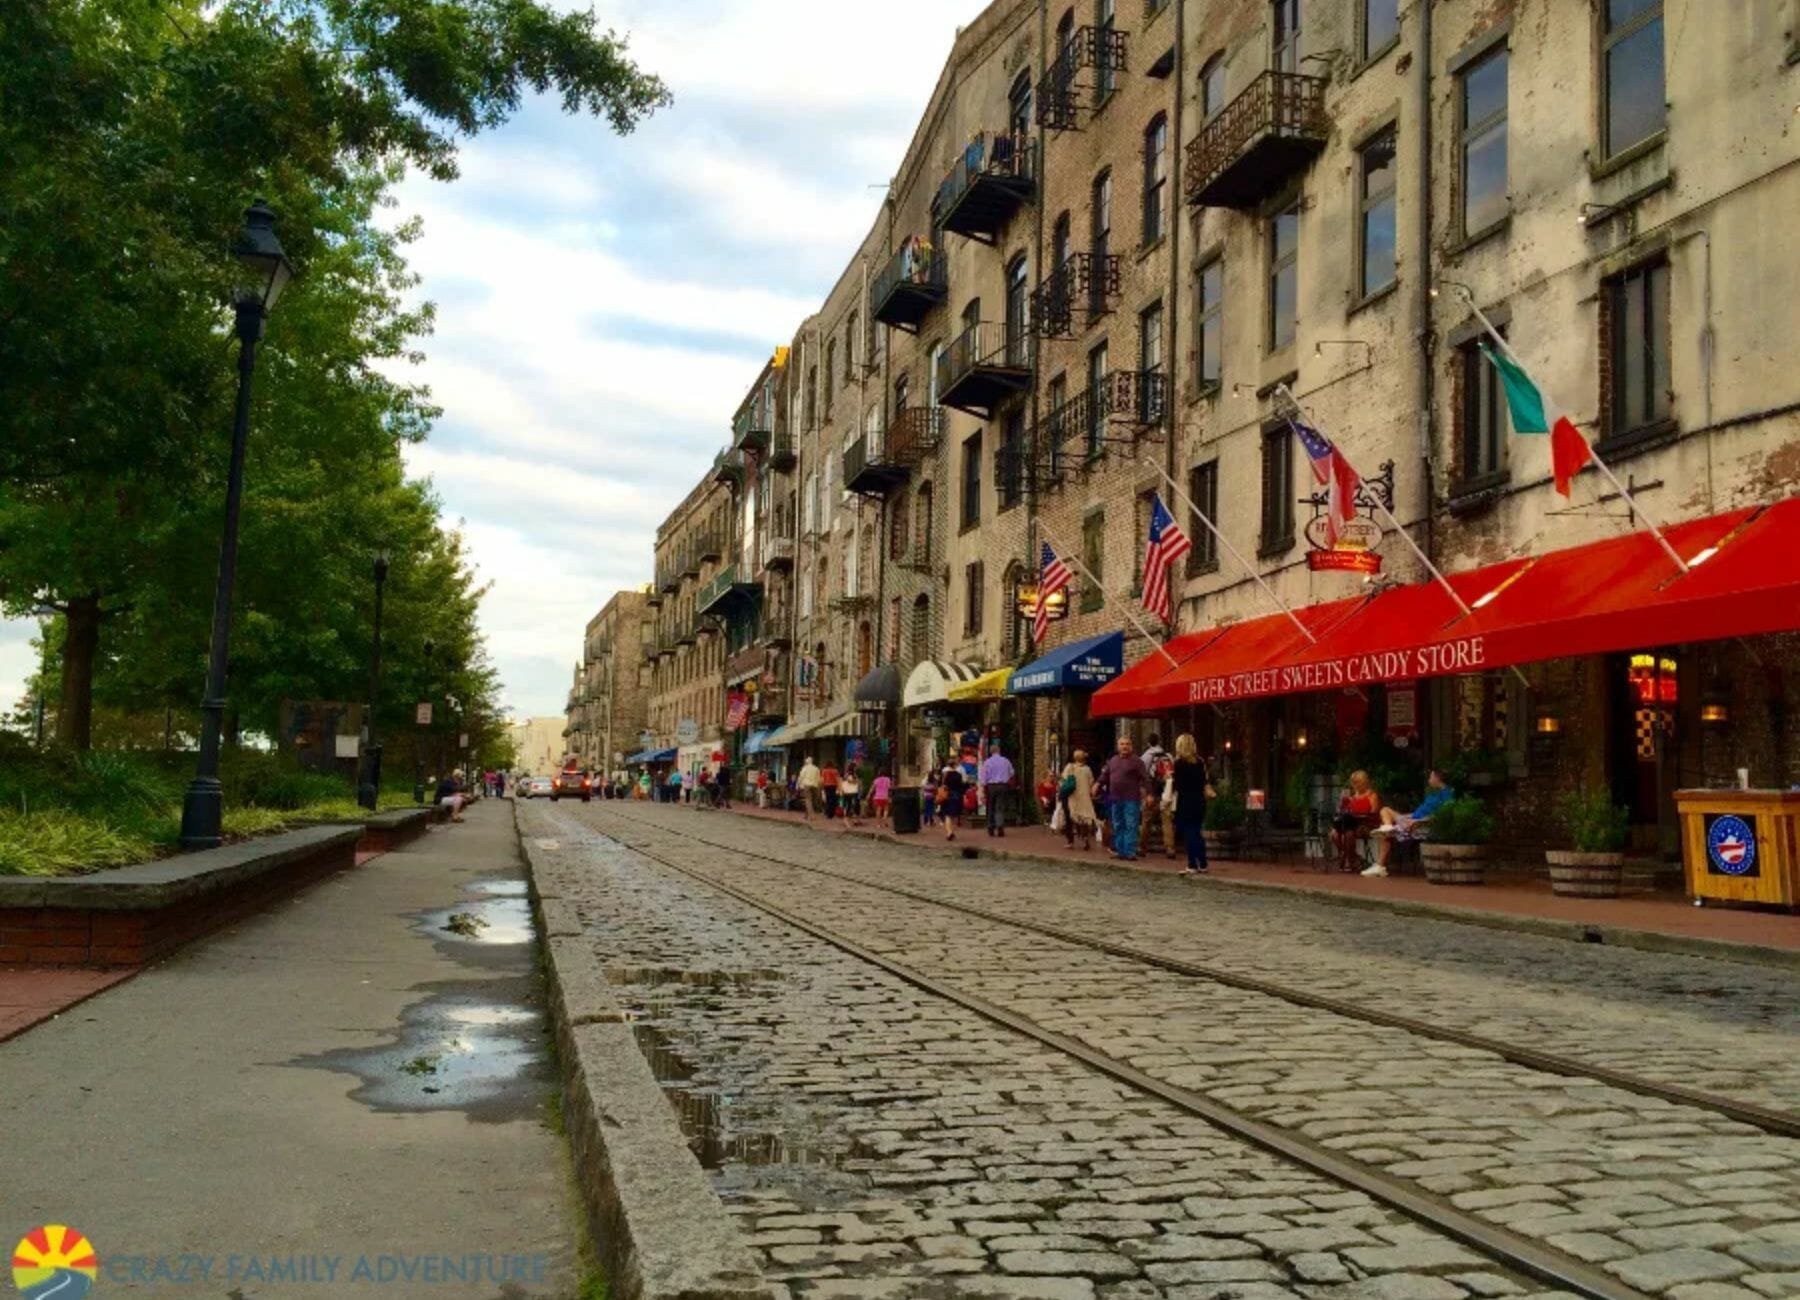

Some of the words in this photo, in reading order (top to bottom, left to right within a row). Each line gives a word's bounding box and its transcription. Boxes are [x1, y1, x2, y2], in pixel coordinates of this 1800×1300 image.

[1189, 677, 1225, 702] RIVER
[1228, 668, 1279, 697] STREET
[1282, 660, 1343, 690] SWEETS
[1347, 650, 1411, 682] CANDY
[1417, 637, 1485, 674] STORE
